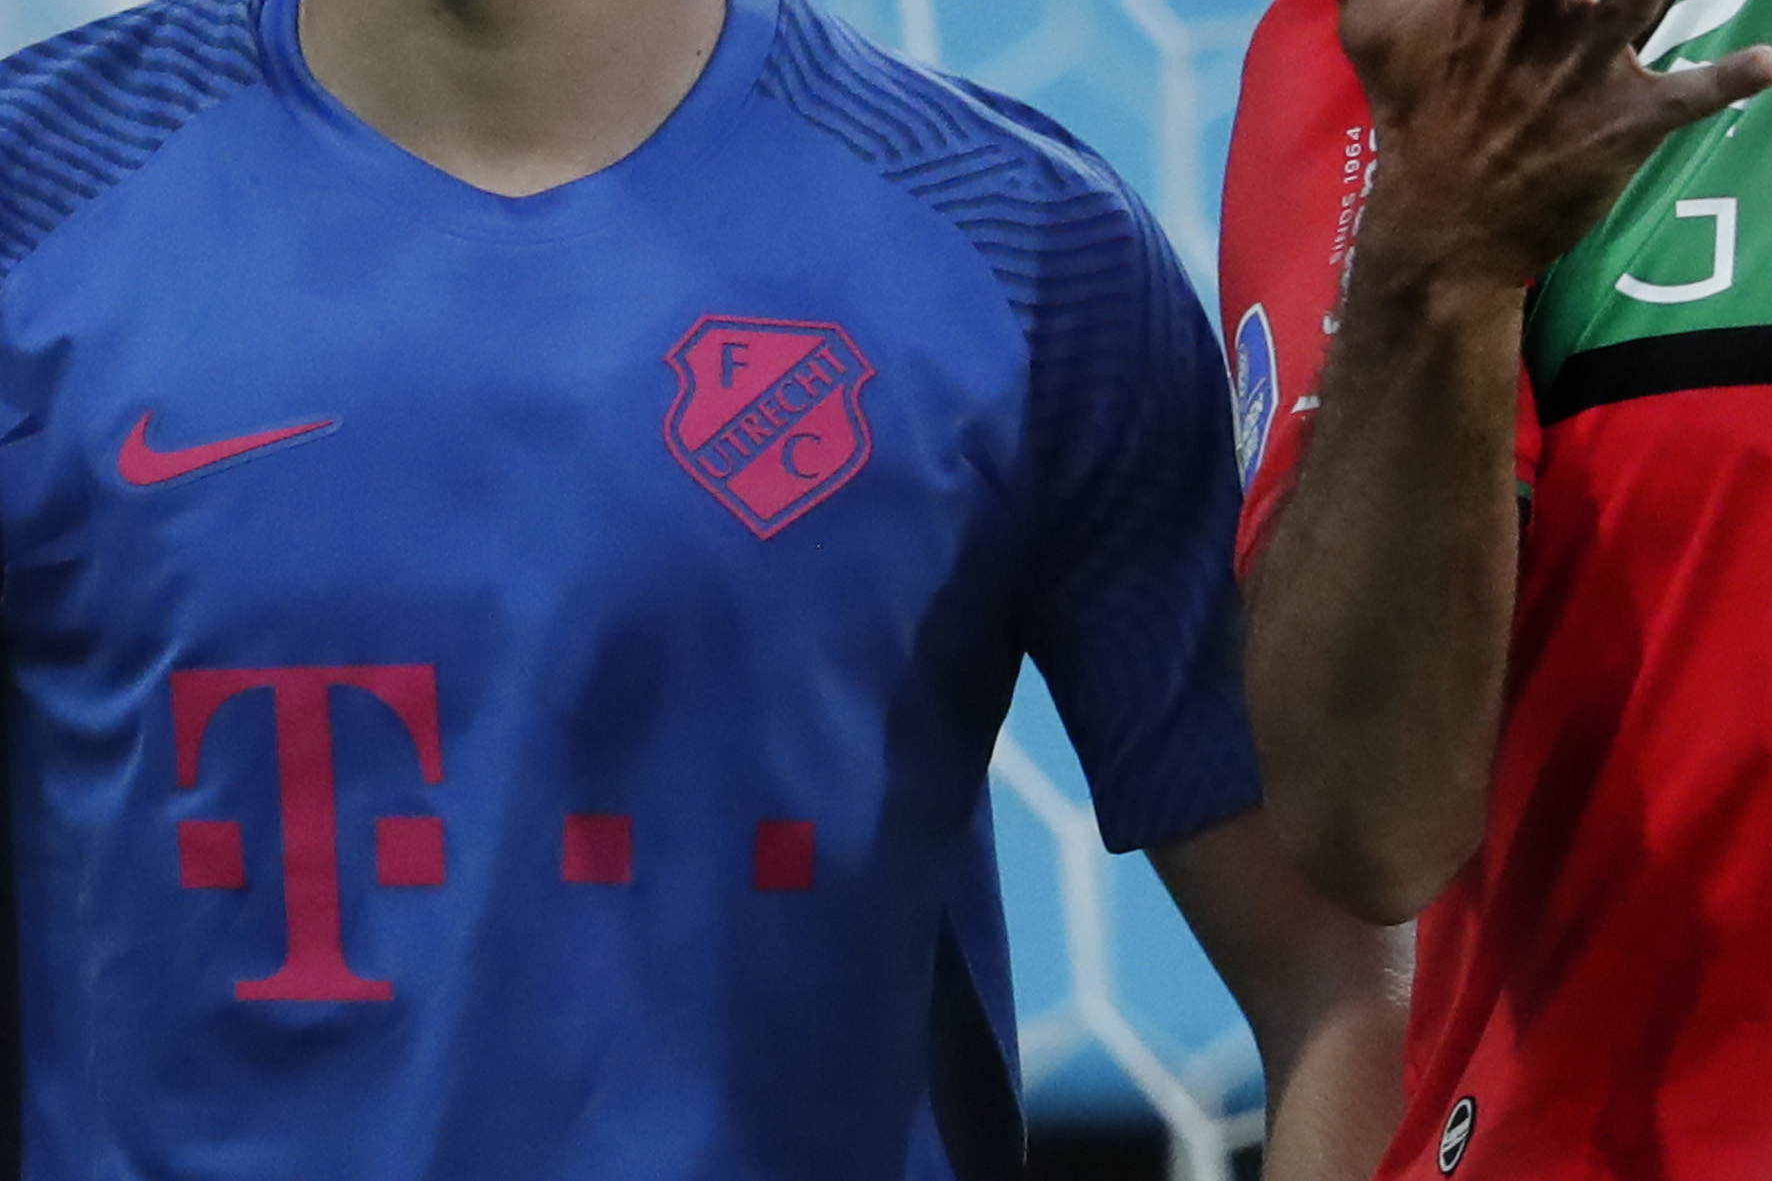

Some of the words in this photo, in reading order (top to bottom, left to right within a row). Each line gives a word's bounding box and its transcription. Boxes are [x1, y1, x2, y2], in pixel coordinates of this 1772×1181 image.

[1344, 126, 1362, 184] 1964
[719, 341, 749, 389] F
[697, 346, 847, 478] UTRECHT
[780, 432, 821, 479] C
